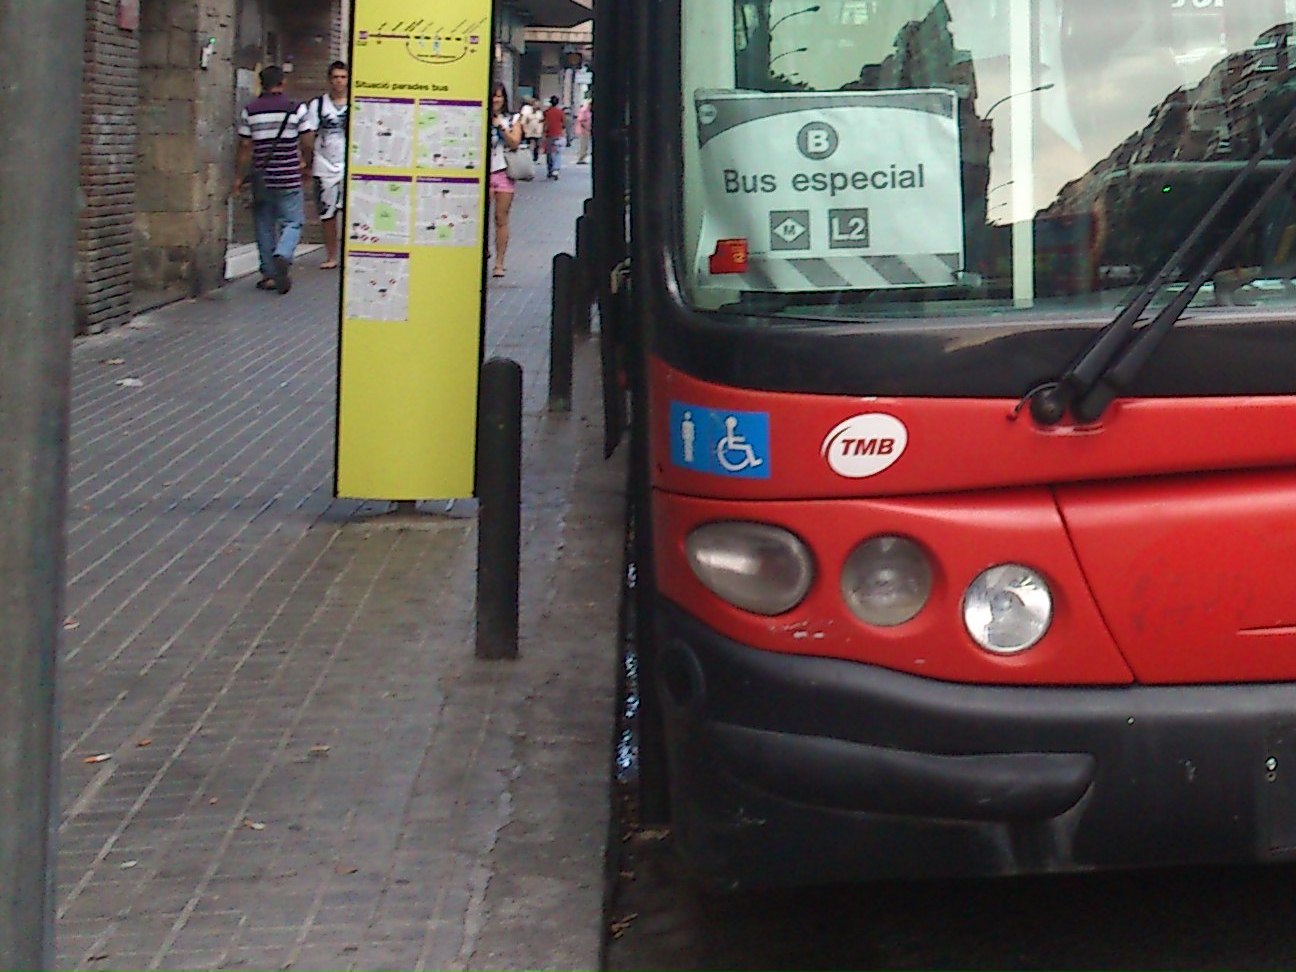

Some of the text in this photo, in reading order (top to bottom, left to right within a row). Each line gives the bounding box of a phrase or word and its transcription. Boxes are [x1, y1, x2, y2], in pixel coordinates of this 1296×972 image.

[431, 83, 449, 92] bus
[805, 128, 830, 154] B
[723, 163, 925, 197] Bus especial
[831, 216, 866, 241] L2
[841, 438, 895, 456] TMB
